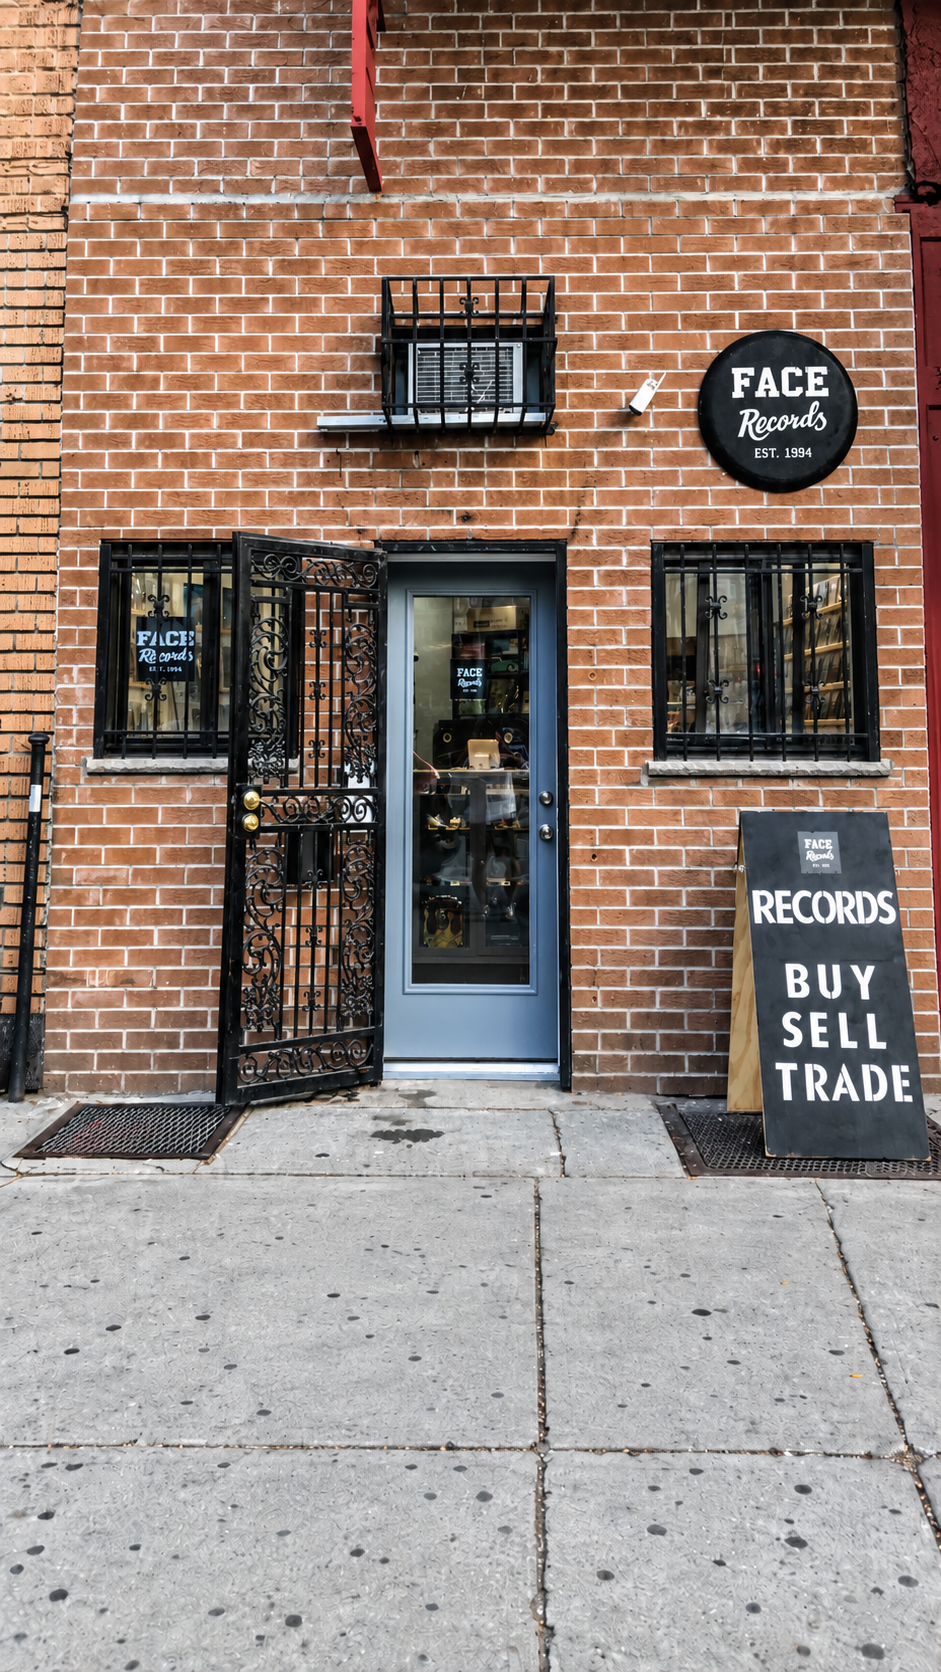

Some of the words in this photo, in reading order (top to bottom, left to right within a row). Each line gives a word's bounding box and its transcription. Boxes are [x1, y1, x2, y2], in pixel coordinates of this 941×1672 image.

[731, 366, 829, 398] FACE
[737, 400, 827, 441] Records
[754, 447, 780, 459] EST.
[784, 447, 812, 458] 1994
[136, 630, 195, 646] FACE
[456, 667, 483, 677] FACE
[803, 838, 833, 849] FACE
[752, 889, 897, 925] RECORDS
[785, 963, 875, 1000] BUY
[781, 1011, 887, 1050] SELL
[775, 1062, 913, 1102] TRADE
